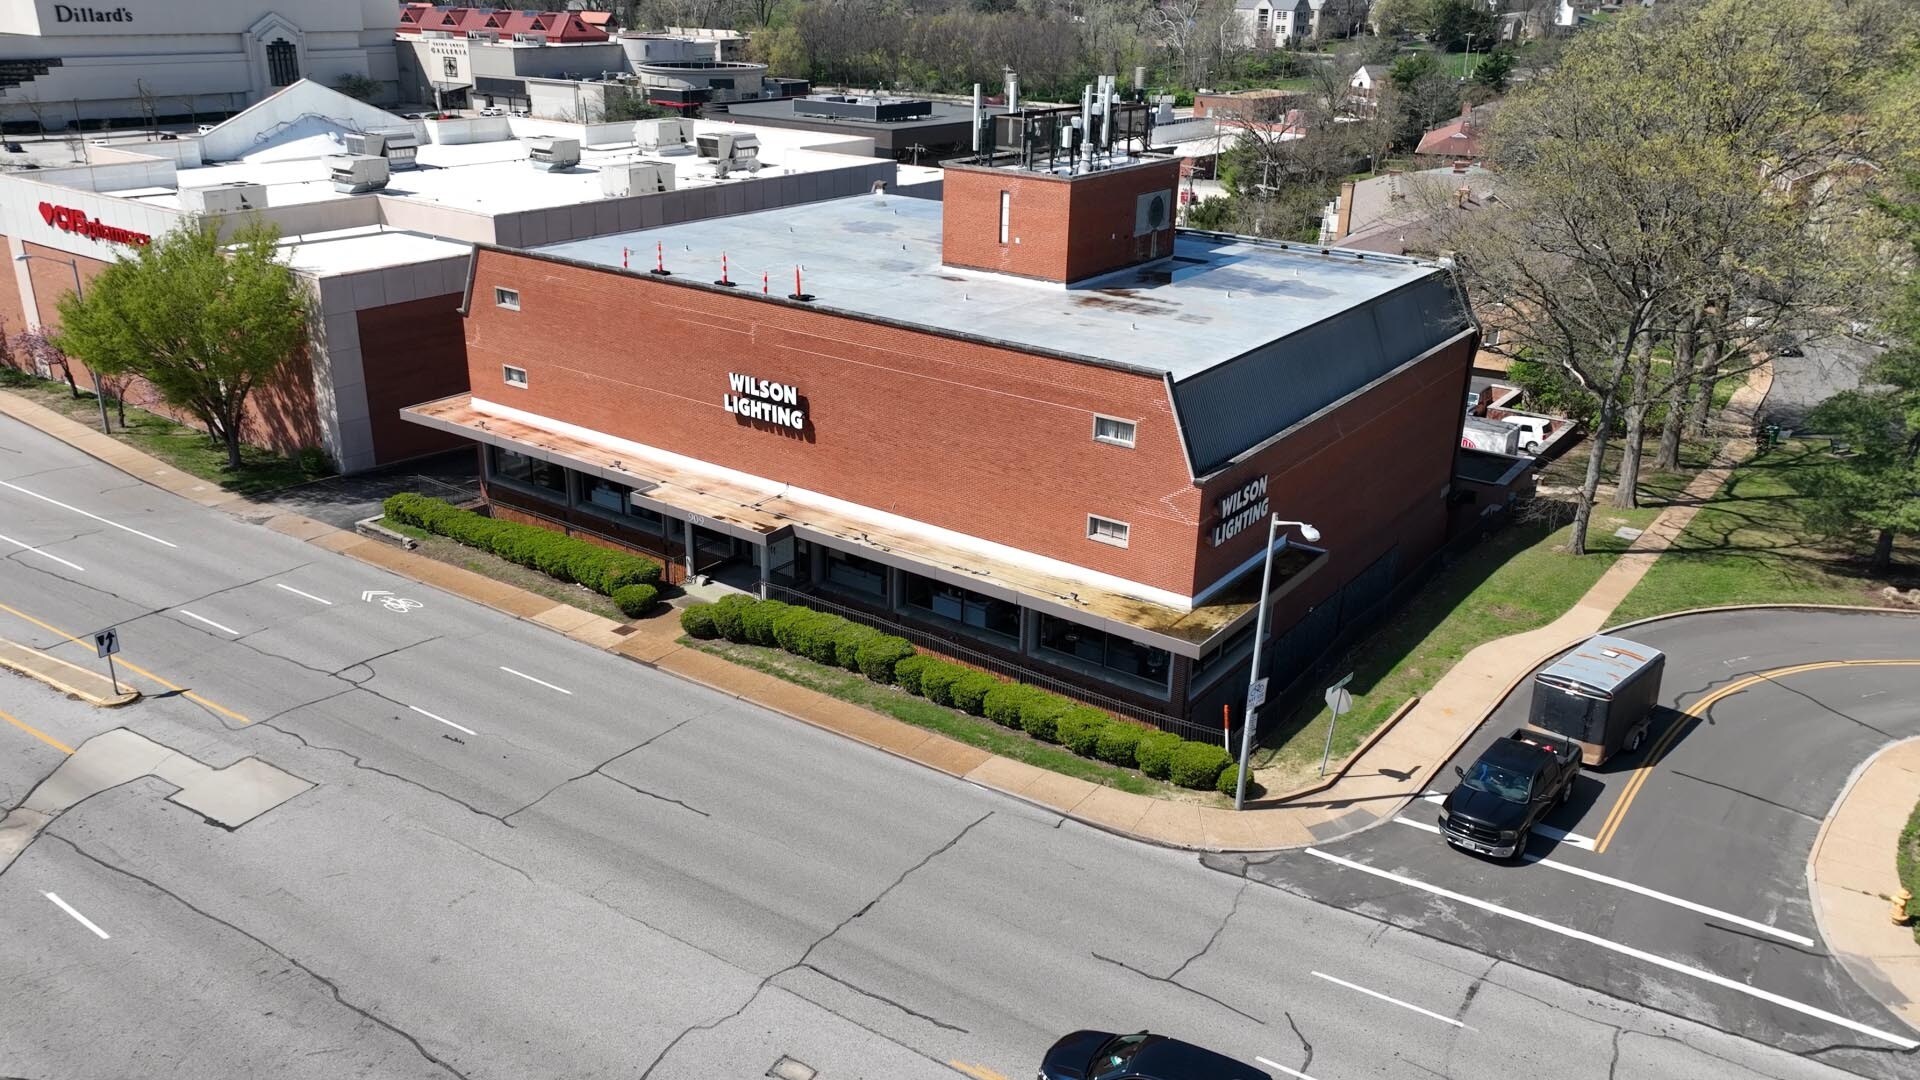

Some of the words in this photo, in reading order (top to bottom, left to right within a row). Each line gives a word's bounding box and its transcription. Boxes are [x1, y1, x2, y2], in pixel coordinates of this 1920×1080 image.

[54, 5, 133, 22] Dillard's
[728, 372, 797, 406] WILSON
[723, 393, 803, 430] LIGHTING
[1222, 474, 1268, 518] WILSON
[687, 512, 705, 526] 909
[1215, 497, 1269, 547] LIGHTING
